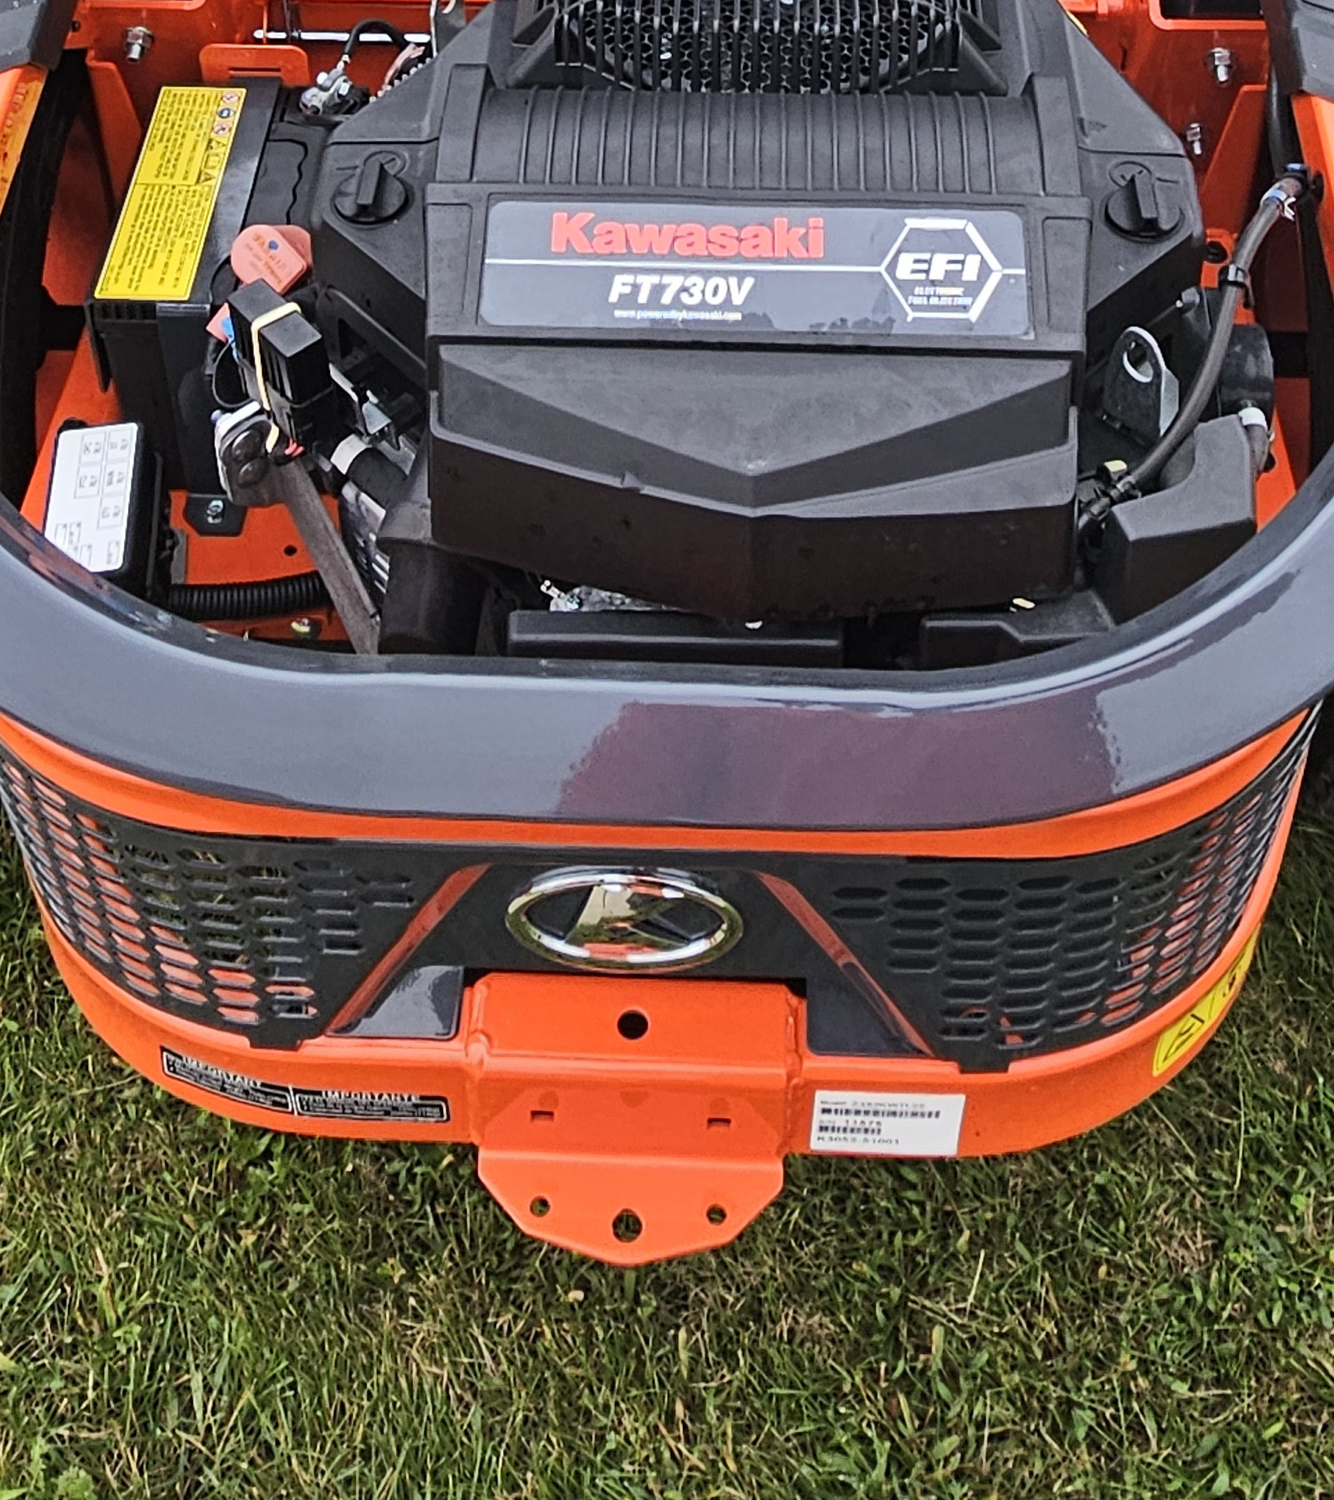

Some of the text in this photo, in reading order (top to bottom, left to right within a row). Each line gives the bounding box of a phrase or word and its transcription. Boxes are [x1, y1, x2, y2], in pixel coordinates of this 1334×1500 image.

[551, 211, 824, 259] Kawasaki
[895, 252, 982, 282] EFI
[608, 274, 755, 306] FT730V
